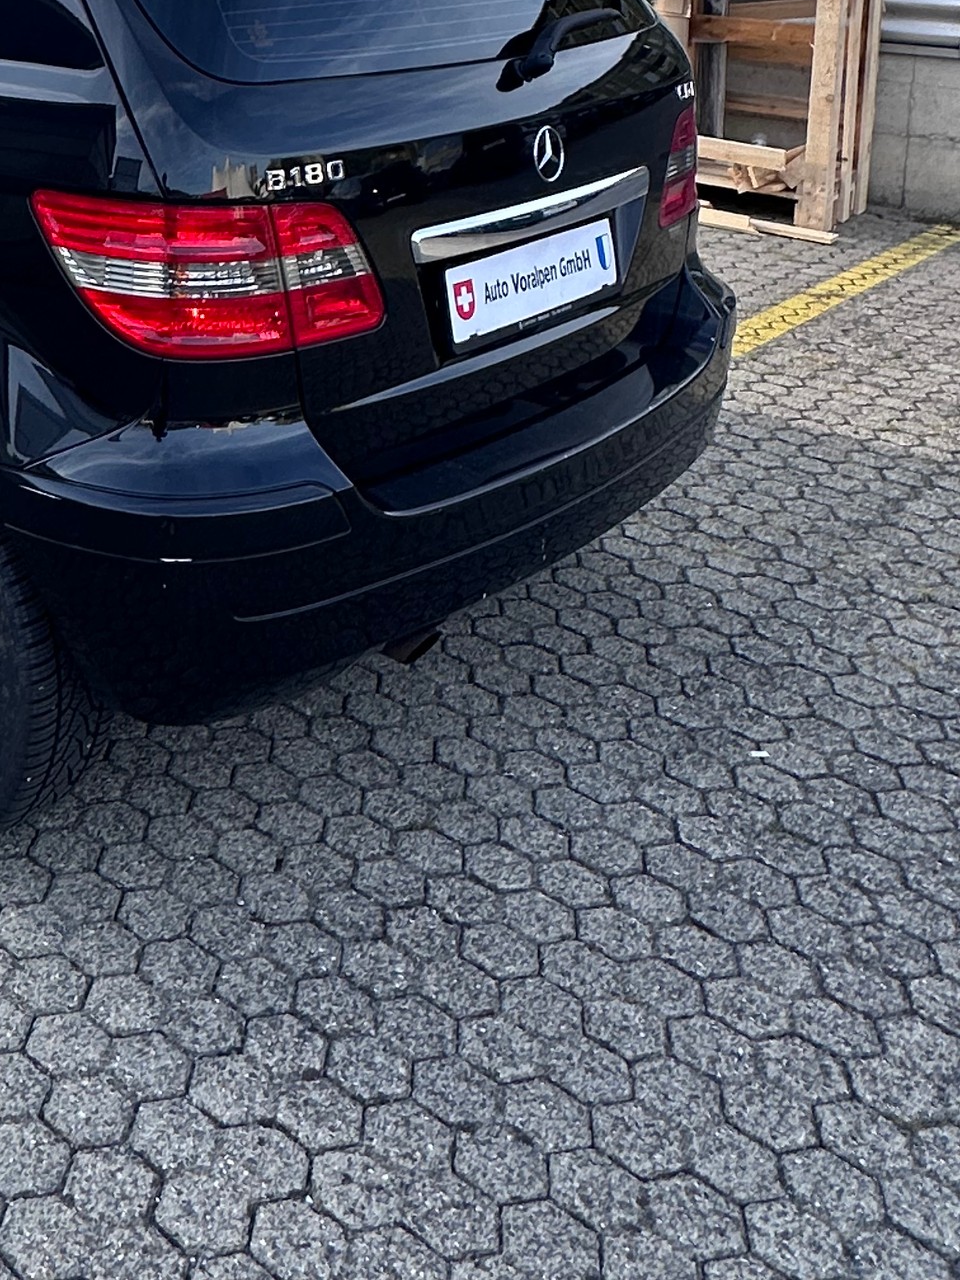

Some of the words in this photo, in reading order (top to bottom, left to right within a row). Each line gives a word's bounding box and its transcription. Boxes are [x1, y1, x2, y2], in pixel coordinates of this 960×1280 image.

[484, 278, 509, 305] Auto
[510, 265, 558, 295] Voralpen
[559, 248, 592, 277] GmbH
